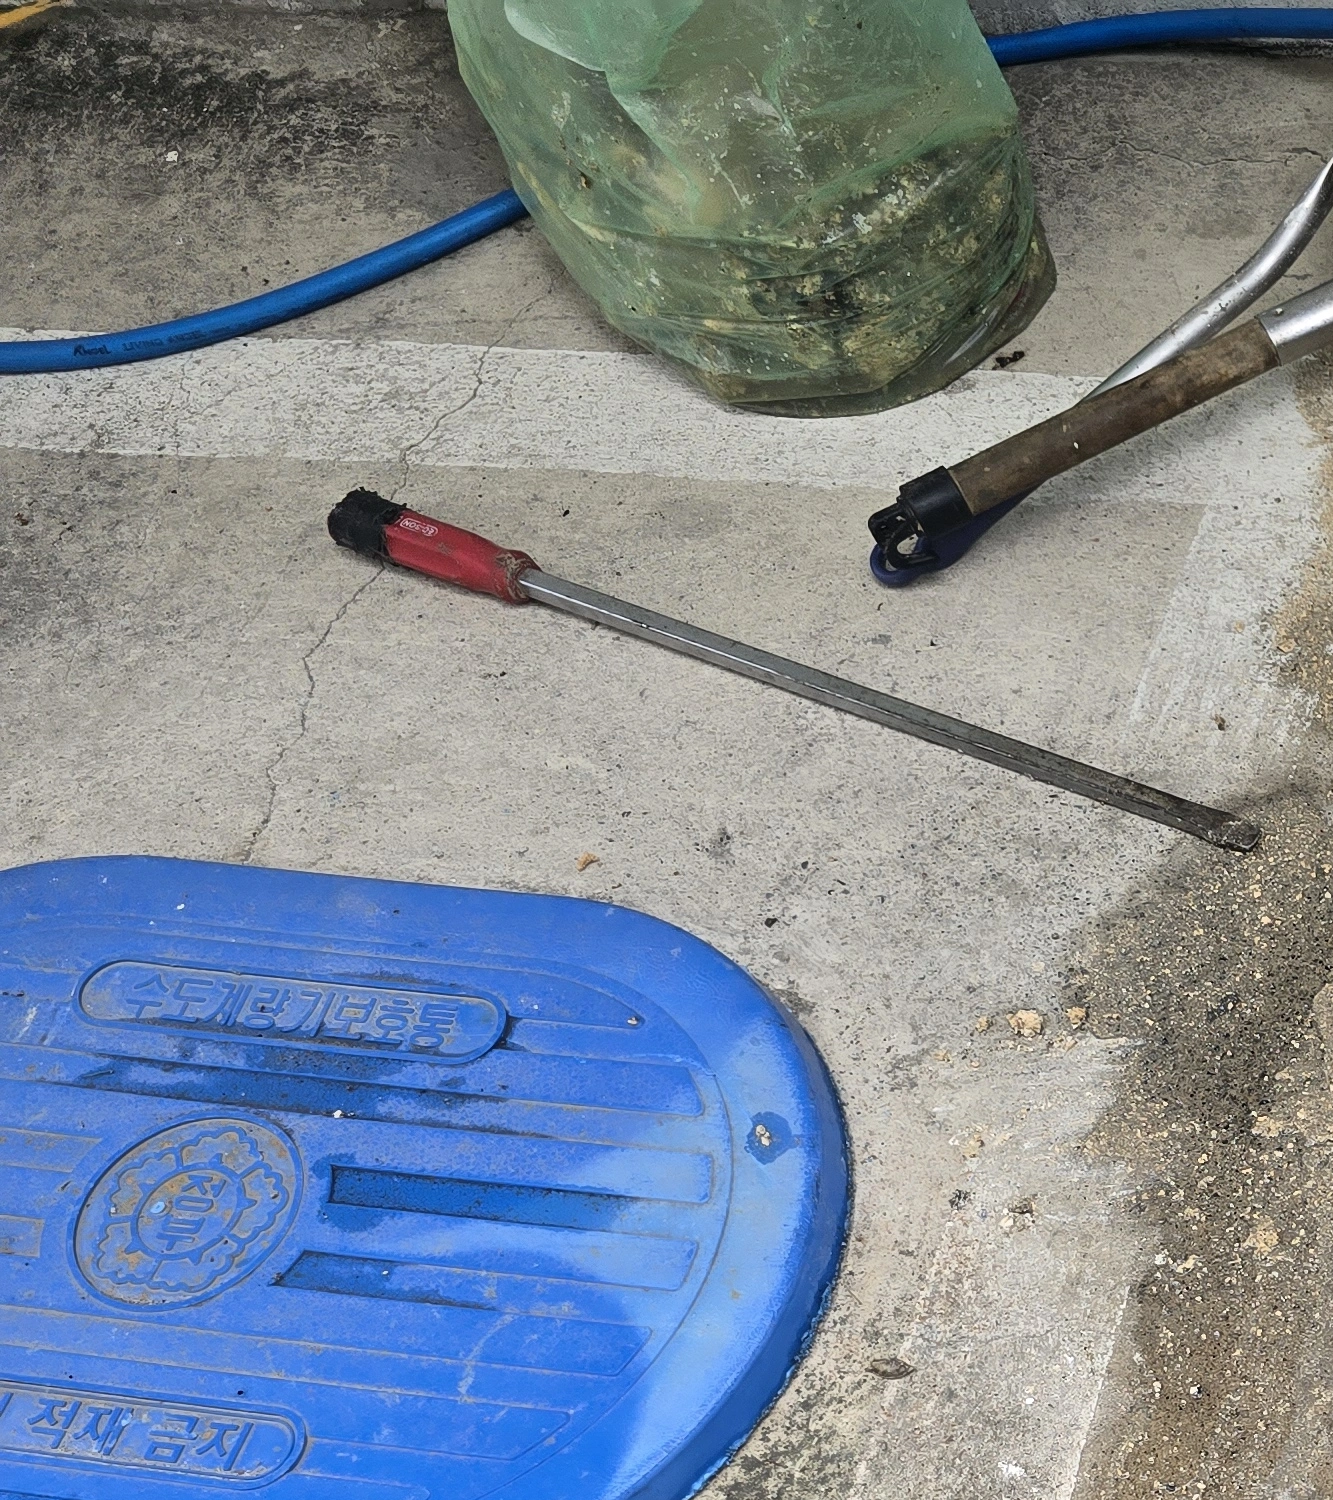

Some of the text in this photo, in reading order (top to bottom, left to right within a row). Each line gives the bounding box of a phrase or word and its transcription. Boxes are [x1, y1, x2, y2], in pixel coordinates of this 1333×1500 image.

[125, 972, 459, 1049] 수도계량기보호통
[156, 1174, 227, 1252] 정부
[27, 1397, 135, 1456] 적재
[143, 1411, 255, 1472] 금지
